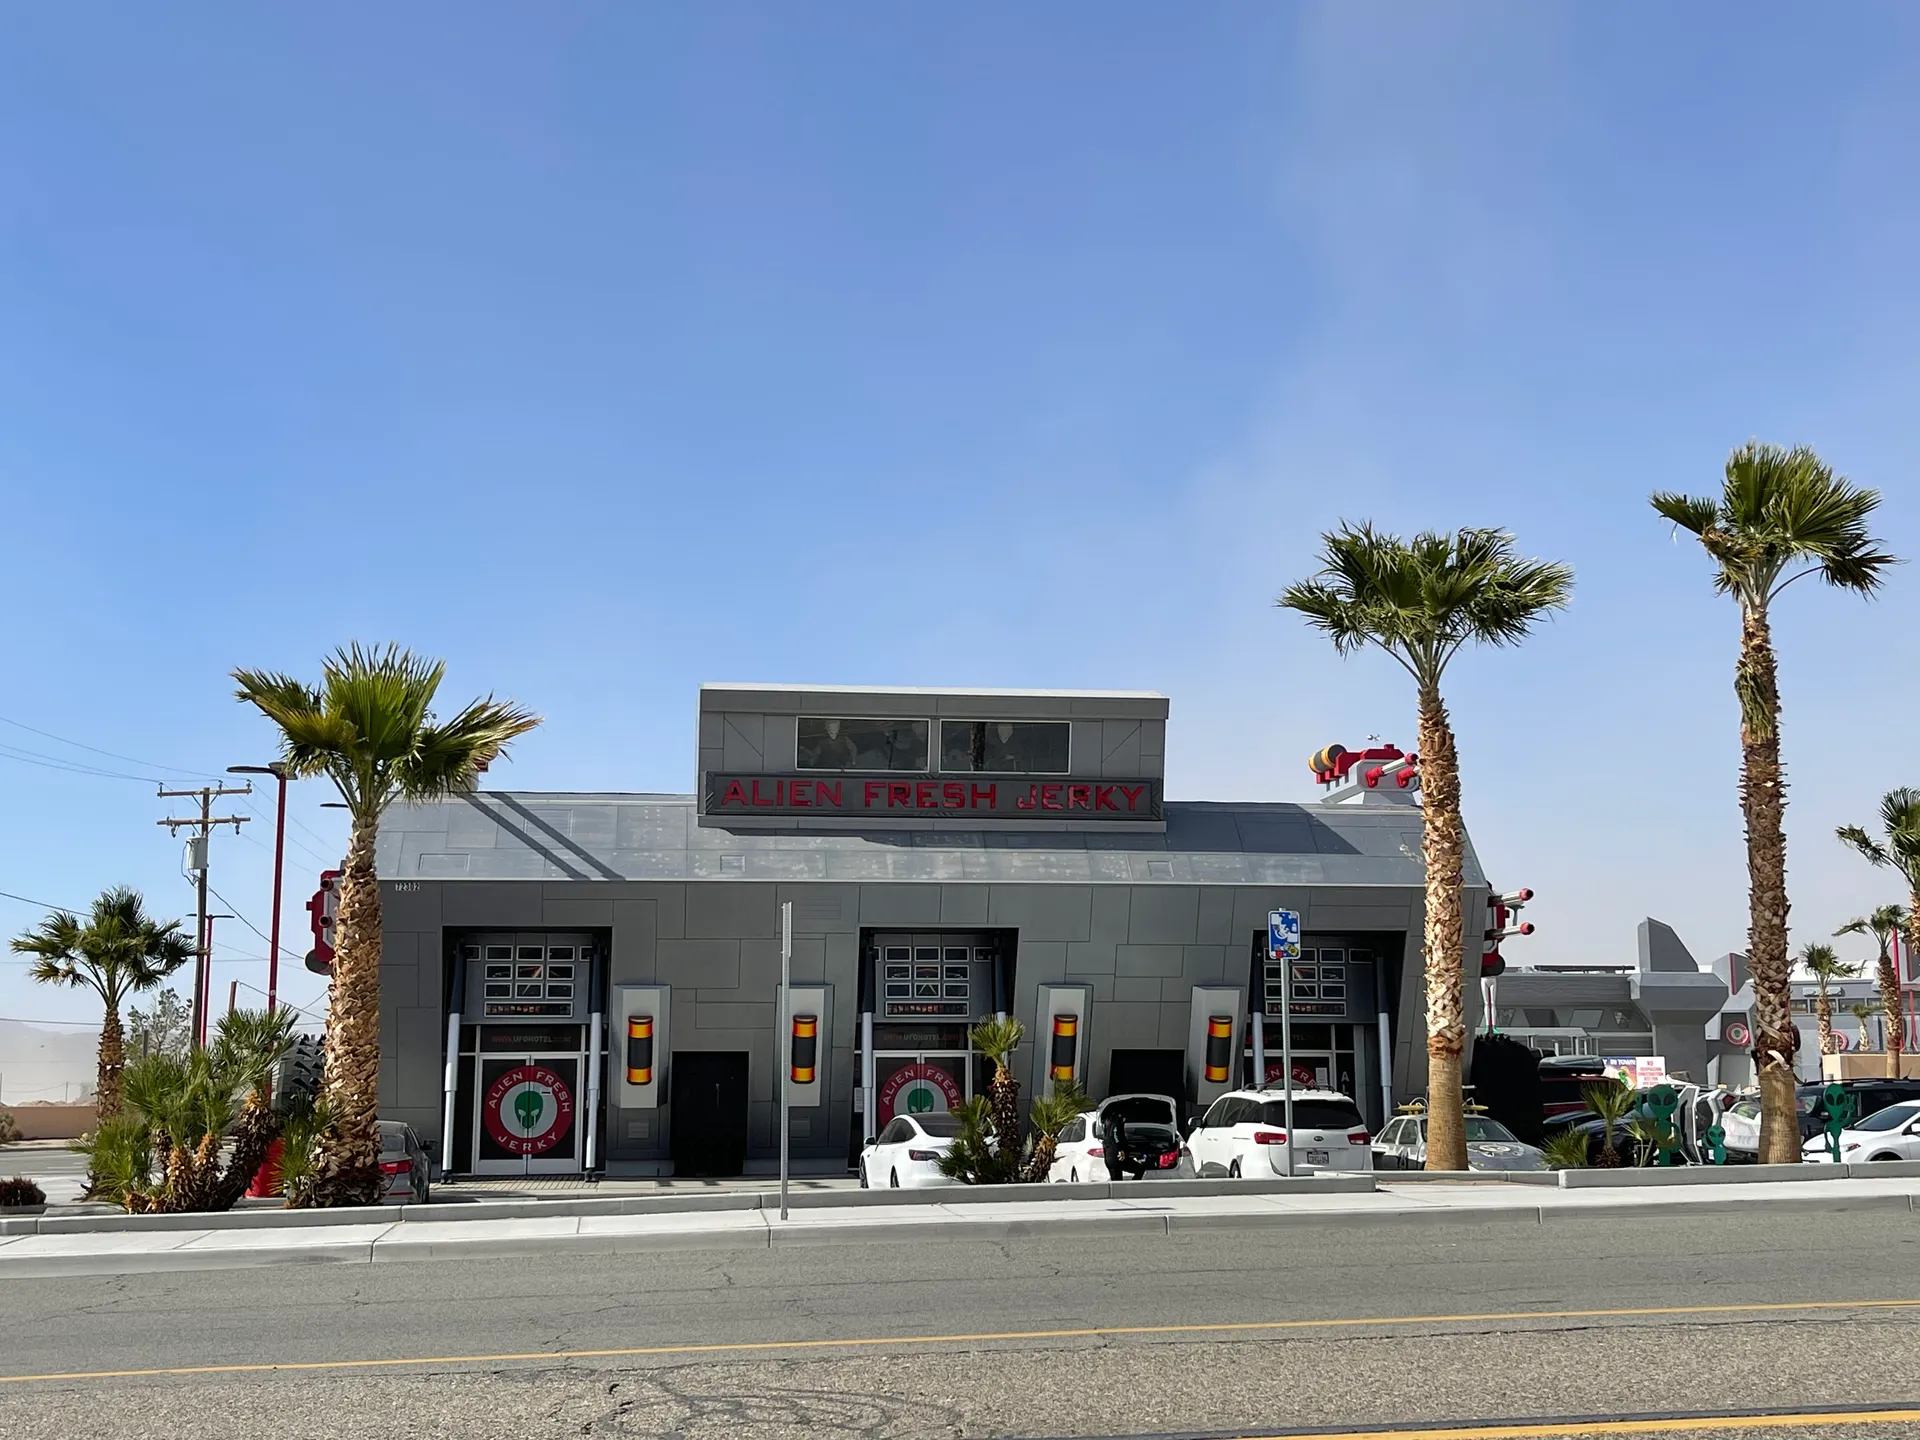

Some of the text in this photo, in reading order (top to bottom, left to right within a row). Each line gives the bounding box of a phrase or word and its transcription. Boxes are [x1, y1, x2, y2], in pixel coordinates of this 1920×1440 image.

[721, 779, 1144, 811] ALIEN FRESH JERKY
[489, 1071, 570, 1112] ALIEN FRESH
[883, 1069, 960, 1109] ALIEN FRESH
[1292, 1068, 1316, 1088] FRE
[498, 1132, 557, 1151] JERKY
